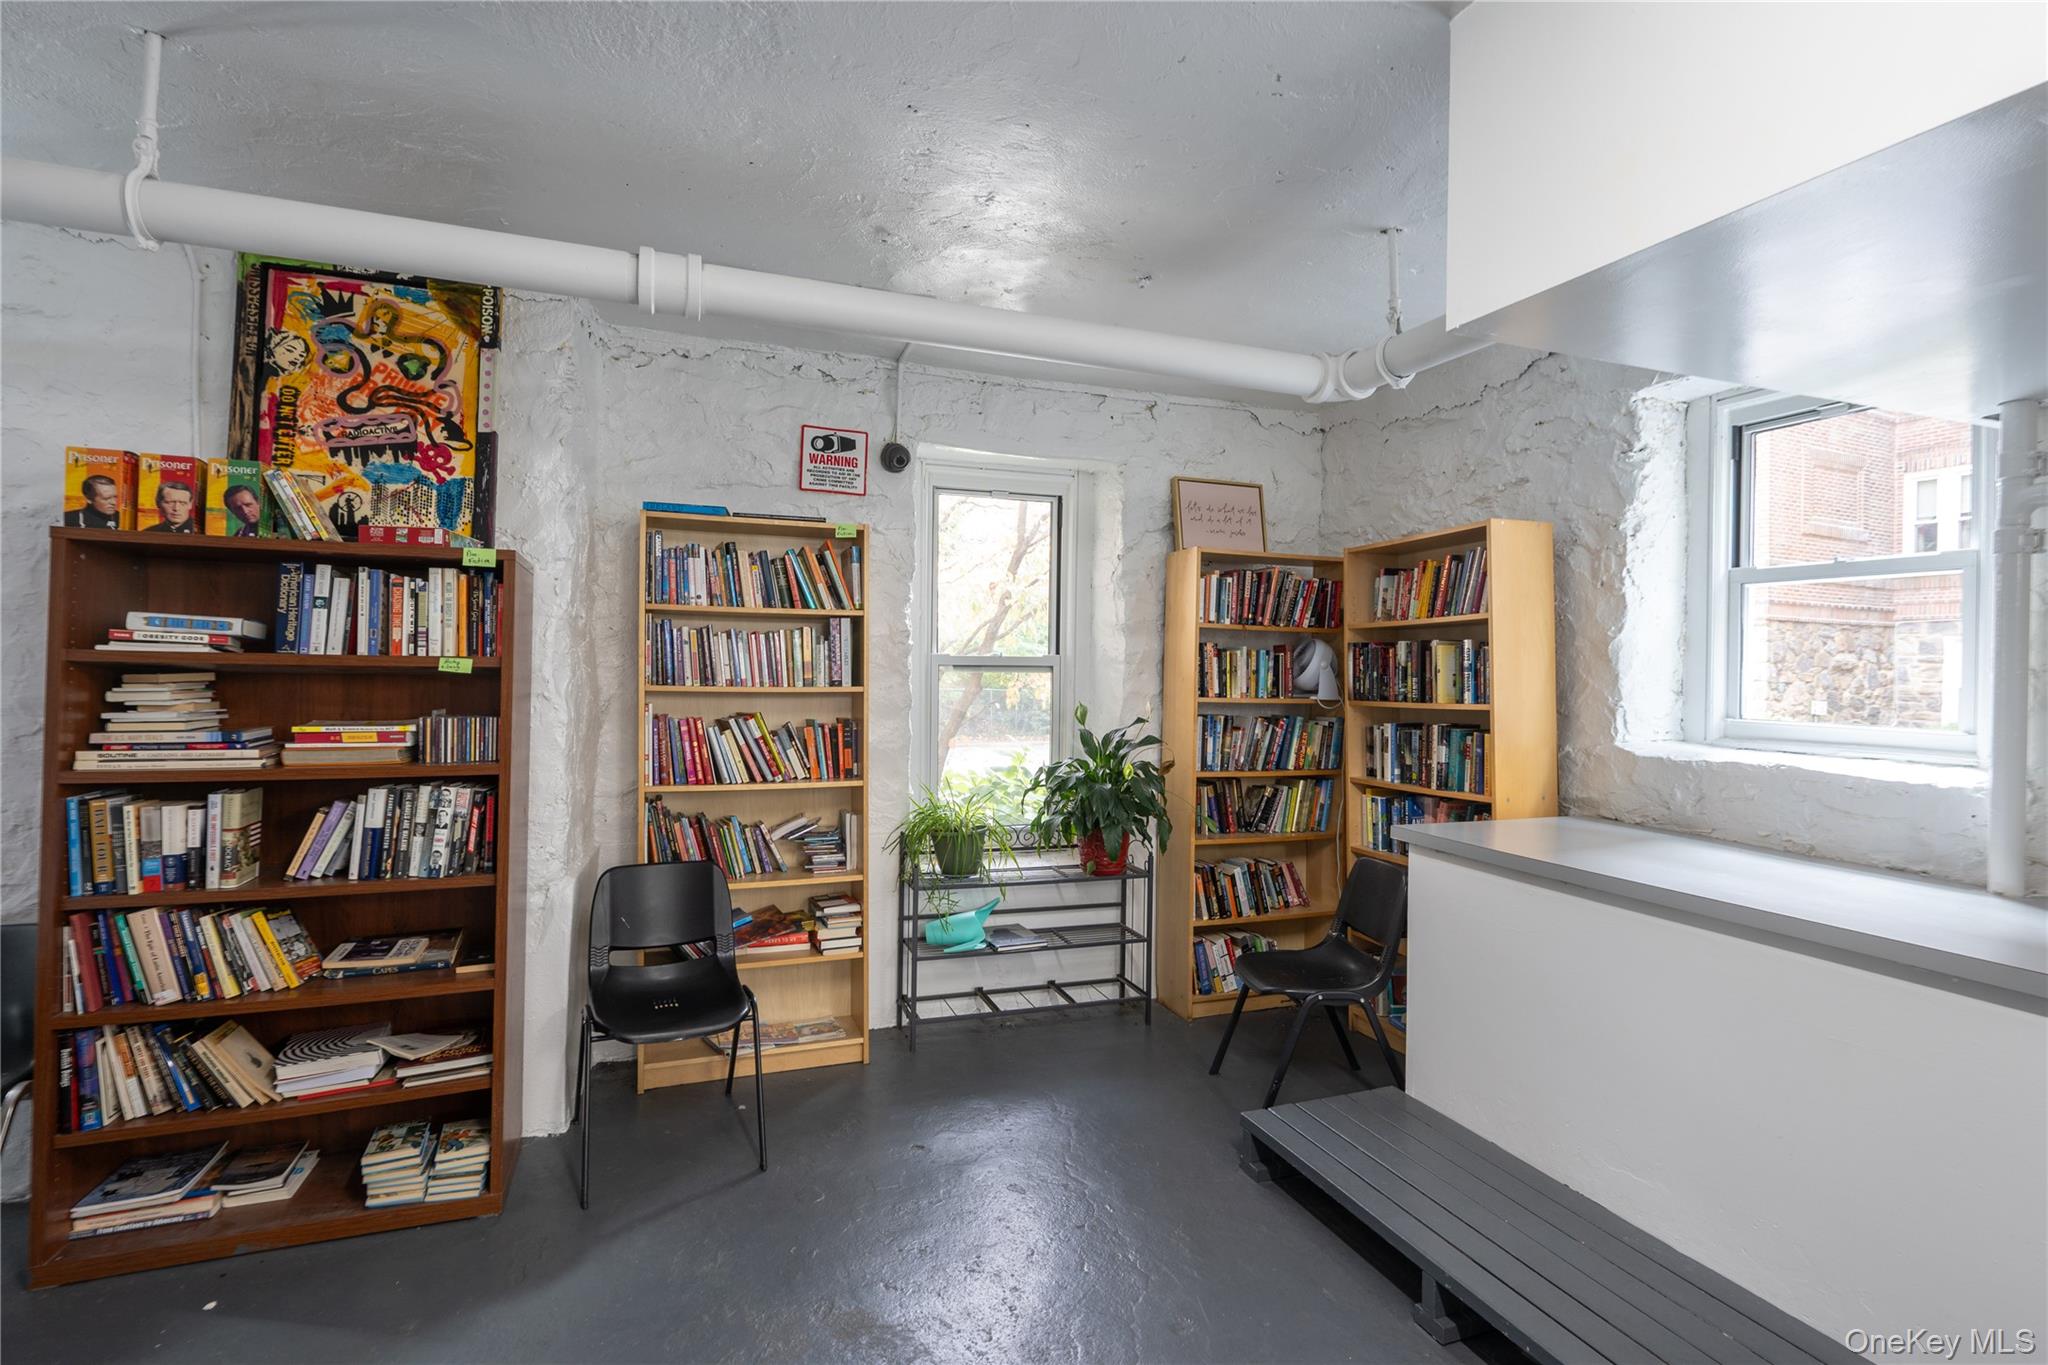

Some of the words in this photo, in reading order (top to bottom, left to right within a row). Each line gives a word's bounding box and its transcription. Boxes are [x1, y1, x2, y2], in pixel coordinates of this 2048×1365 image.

[481, 287, 494, 335] POISON
[808, 453, 858, 468] WARNING
[277, 574, 290, 614] Dictionary
[287, 566, 300, 606] American
[392, 586, 403, 613] CHASING
[285, 607, 298, 641] Heritage
[392, 614, 402, 628] TIME
[94, 809, 105, 835] BALL
[400, 830, 408, 851] WALKING
